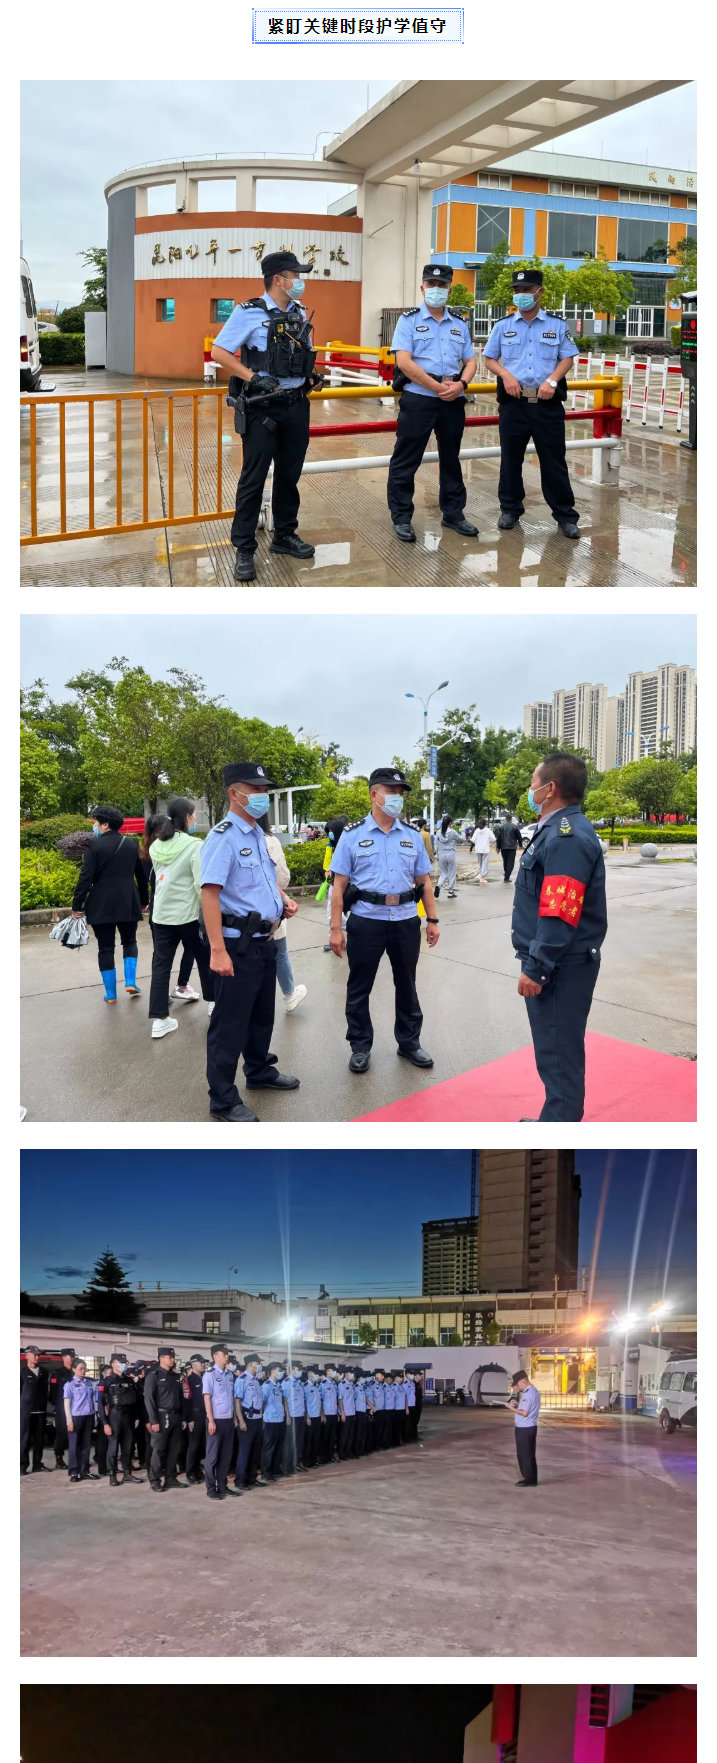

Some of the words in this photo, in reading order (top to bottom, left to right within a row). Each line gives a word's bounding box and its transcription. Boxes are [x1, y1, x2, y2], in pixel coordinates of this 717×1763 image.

[268, 17, 447, 35] 紧盯关键时段护学值守
